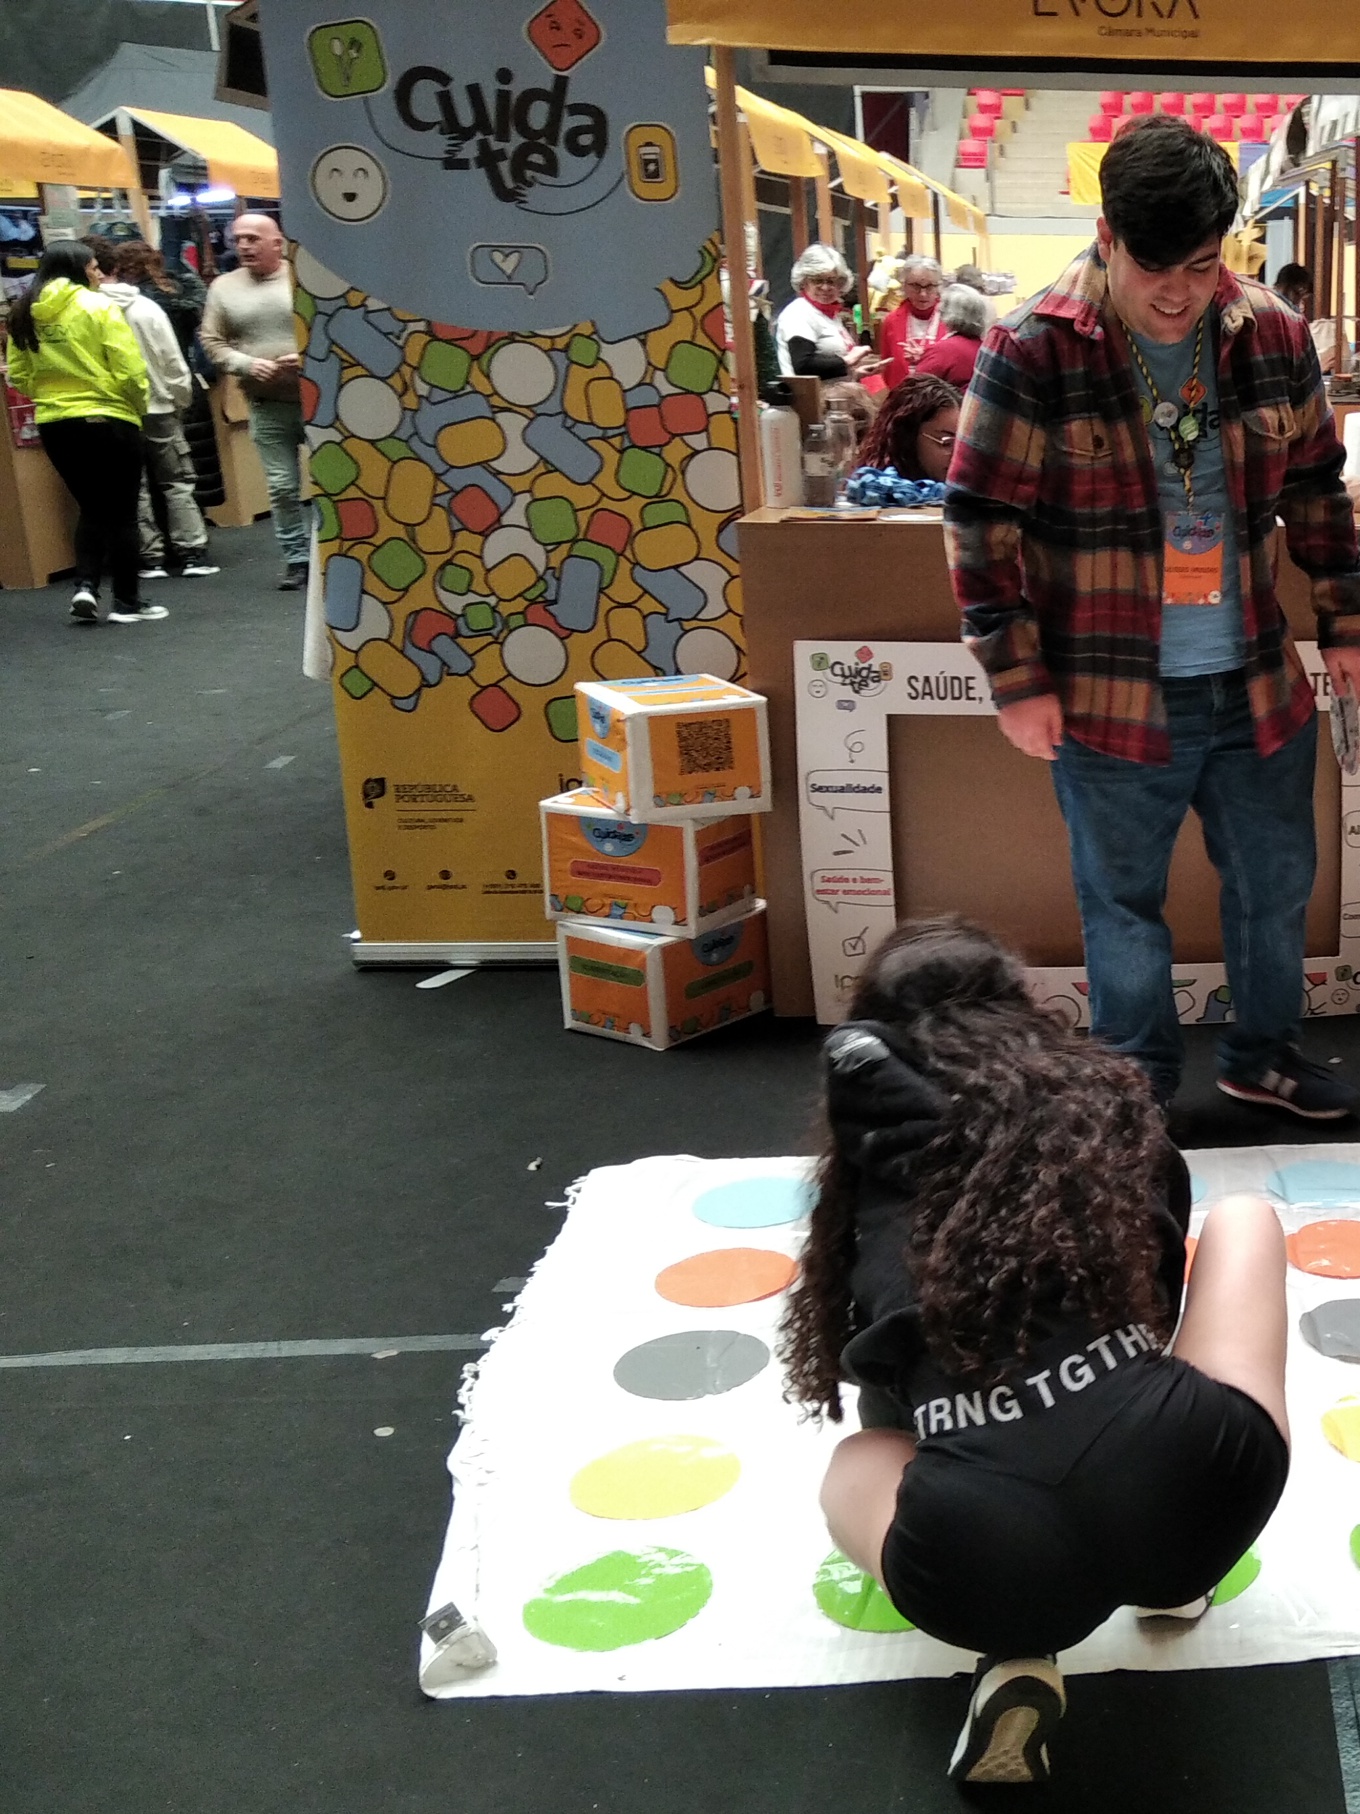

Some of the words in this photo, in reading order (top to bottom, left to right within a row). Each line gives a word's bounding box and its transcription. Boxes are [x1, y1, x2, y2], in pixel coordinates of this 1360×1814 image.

[394, 65, 609, 160] Cuida
[906, 670, 984, 704] SAÚDE,
[393, 782, 461, 794] REPÚBLICA
[809, 782, 883, 795] Sexualidade
[395, 794, 476, 804] PORTUGUESA
[820, 875, 850, 885] Saúde
[841, 887, 892, 897] emocional
